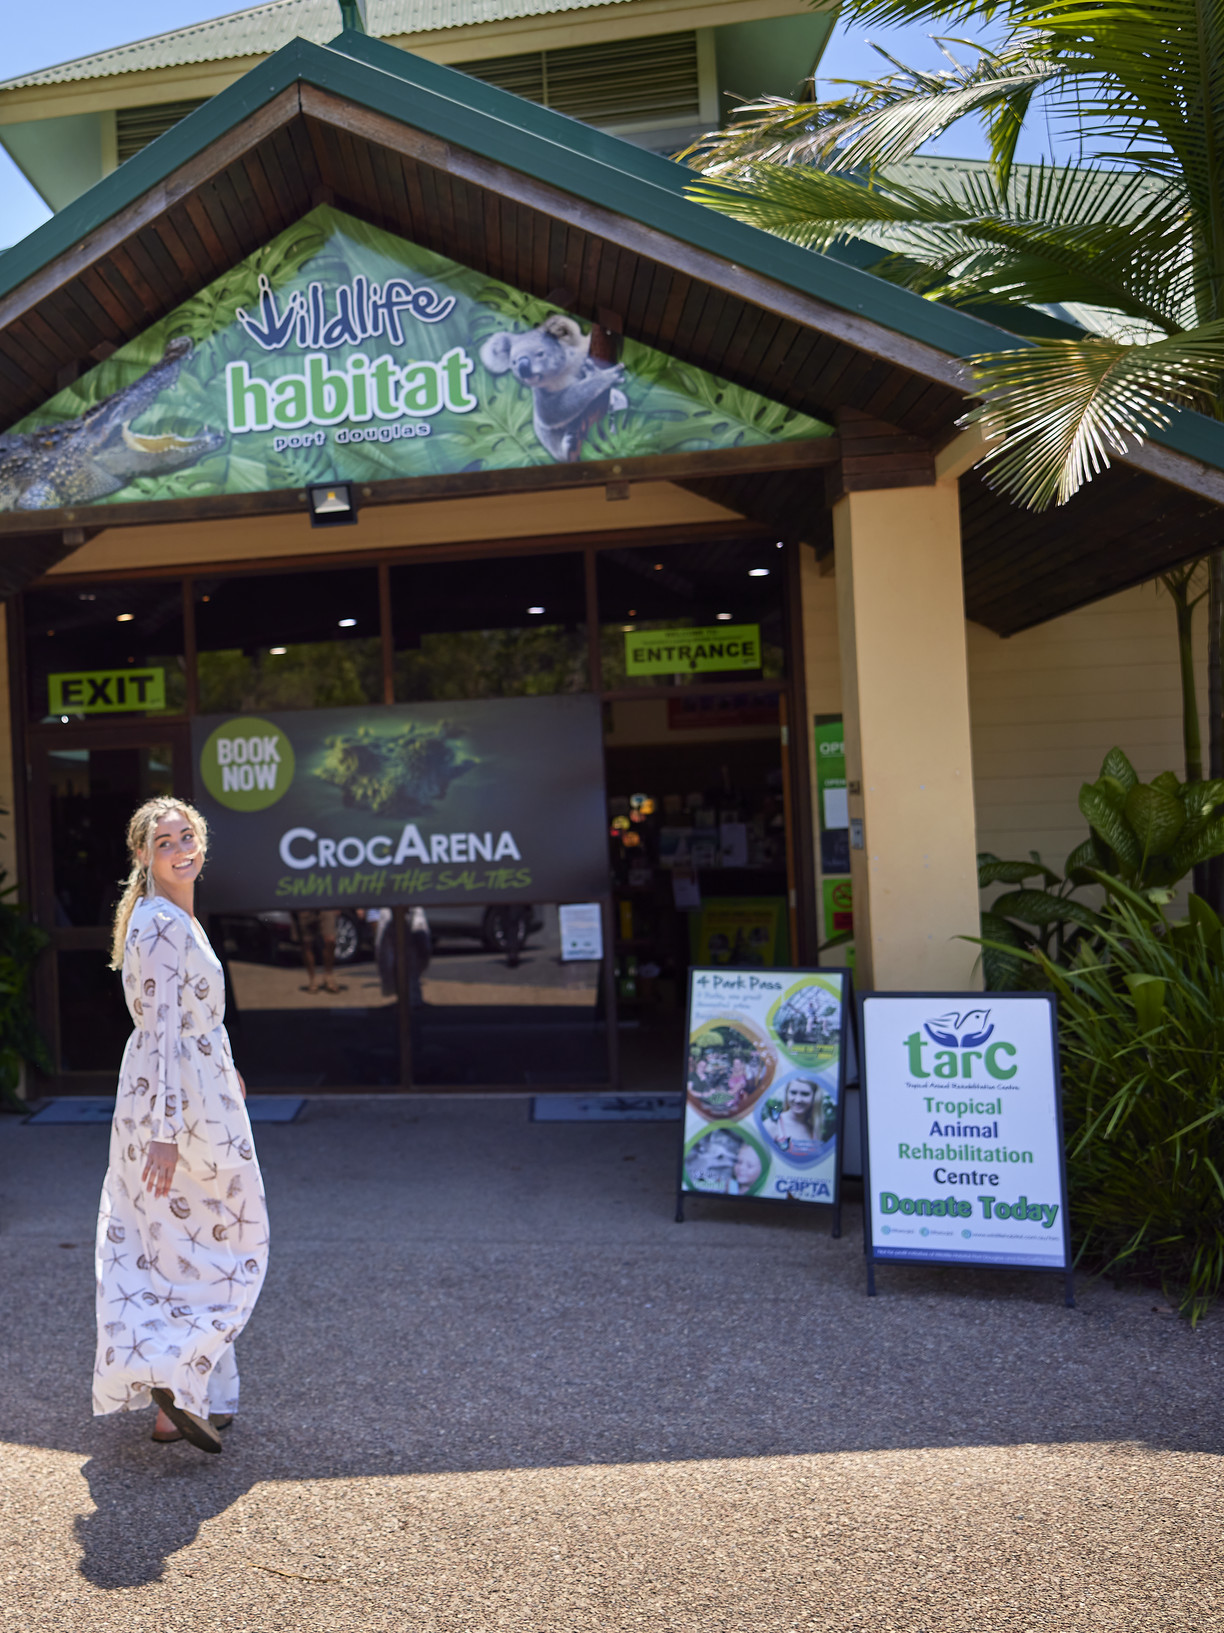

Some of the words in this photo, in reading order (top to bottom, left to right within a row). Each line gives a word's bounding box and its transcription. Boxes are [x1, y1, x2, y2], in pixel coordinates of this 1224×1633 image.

[236, 273, 456, 349] Wildlife
[226, 347, 477, 433] habitat
[274, 431, 325, 451] port
[335, 423, 431, 444] douglas
[632, 641, 755, 662] ENTRANCE
[61, 675, 154, 707] EXIT
[217, 735, 281, 765] BOOK
[222, 763, 278, 792] NOW
[276, 873, 333, 896] SWIM
[337, 869, 387, 896] WITH
[389, 867, 434, 894] THE
[435, 867, 532, 890] SALTIES
[697, 976, 709, 988] 4
[713, 975, 746, 989] Park
[750, 976, 782, 990] Pass
[923, 1097, 1002, 1118] Tropical
[929, 1121, 999, 1138] Animal
[898, 1143, 1034, 1163] Rehabilitation
[933, 1167, 999, 1186] Centre
[879, 1191, 973, 1218] Donate
[978, 1195, 1059, 1229] Today
